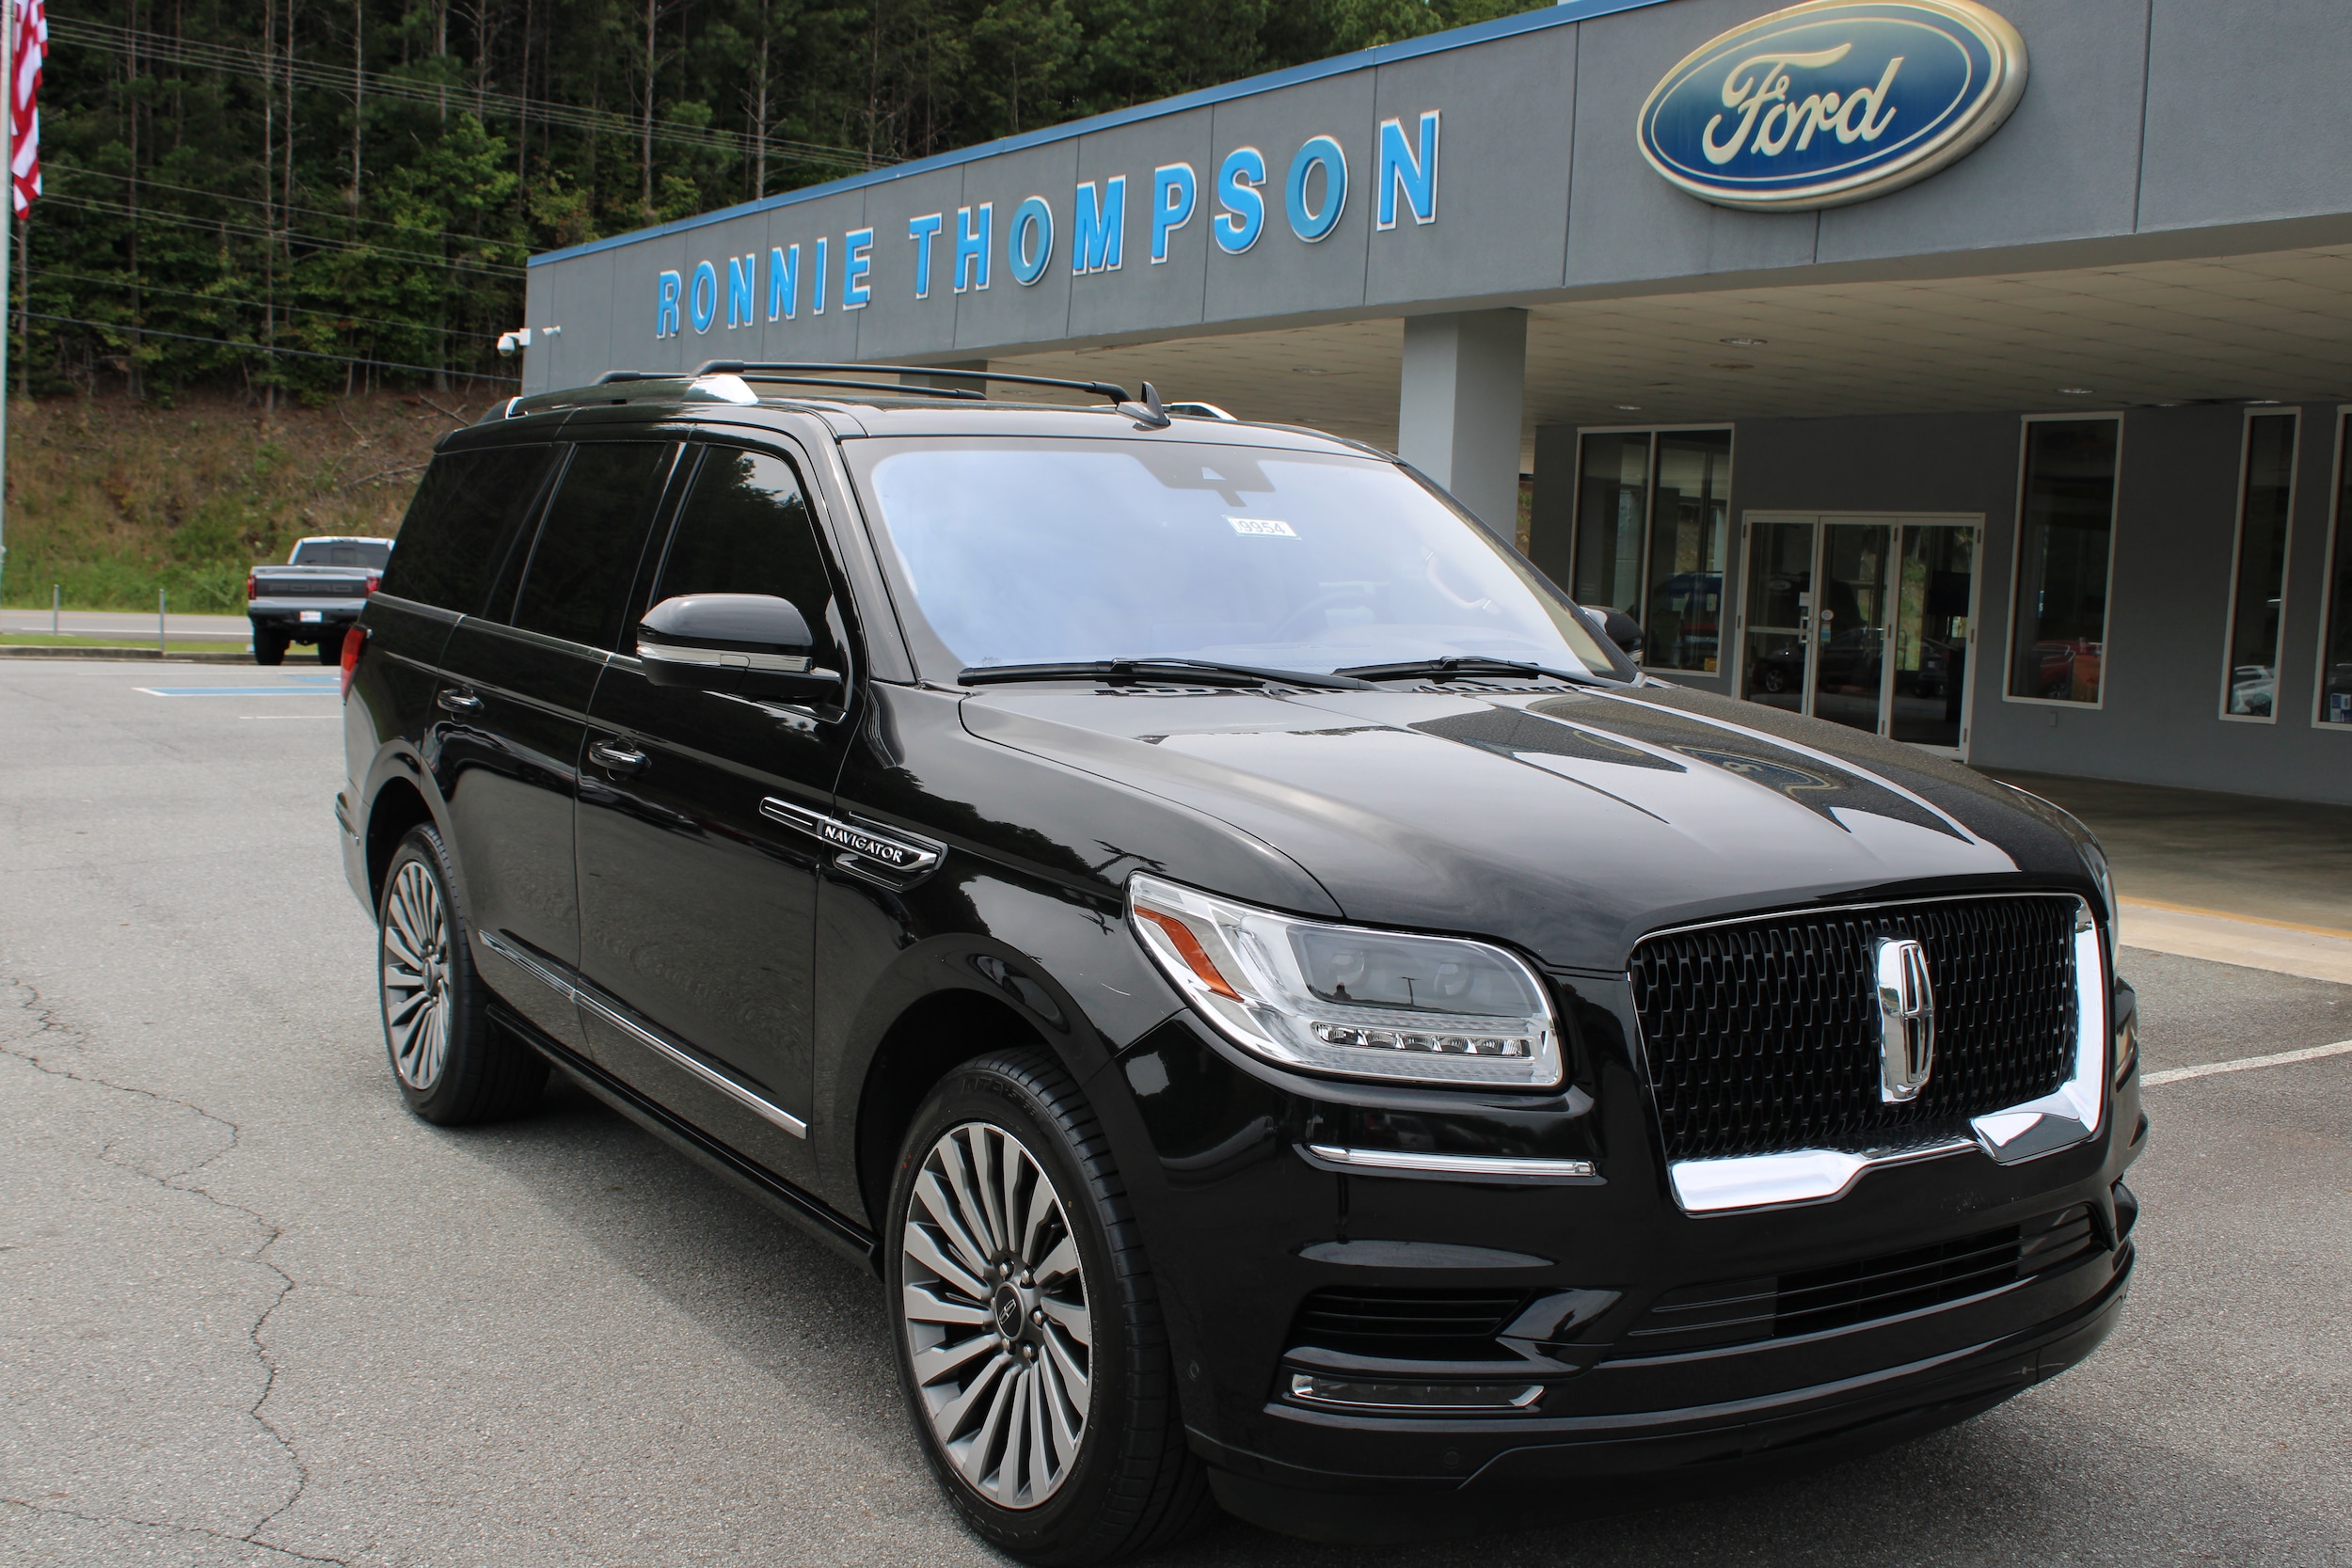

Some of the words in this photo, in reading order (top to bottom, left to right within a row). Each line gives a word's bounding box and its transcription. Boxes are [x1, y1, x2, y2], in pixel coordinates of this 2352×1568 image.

[1702, 42, 1904, 165] Ford
[657, 227, 874, 341] RONNIE
[909, 109, 1442, 300] THOMPSON
[1237, 520, 1286, 534] 9954
[269, 583, 354, 593] FORD
[824, 825, 903, 863] NAVIGATOR
